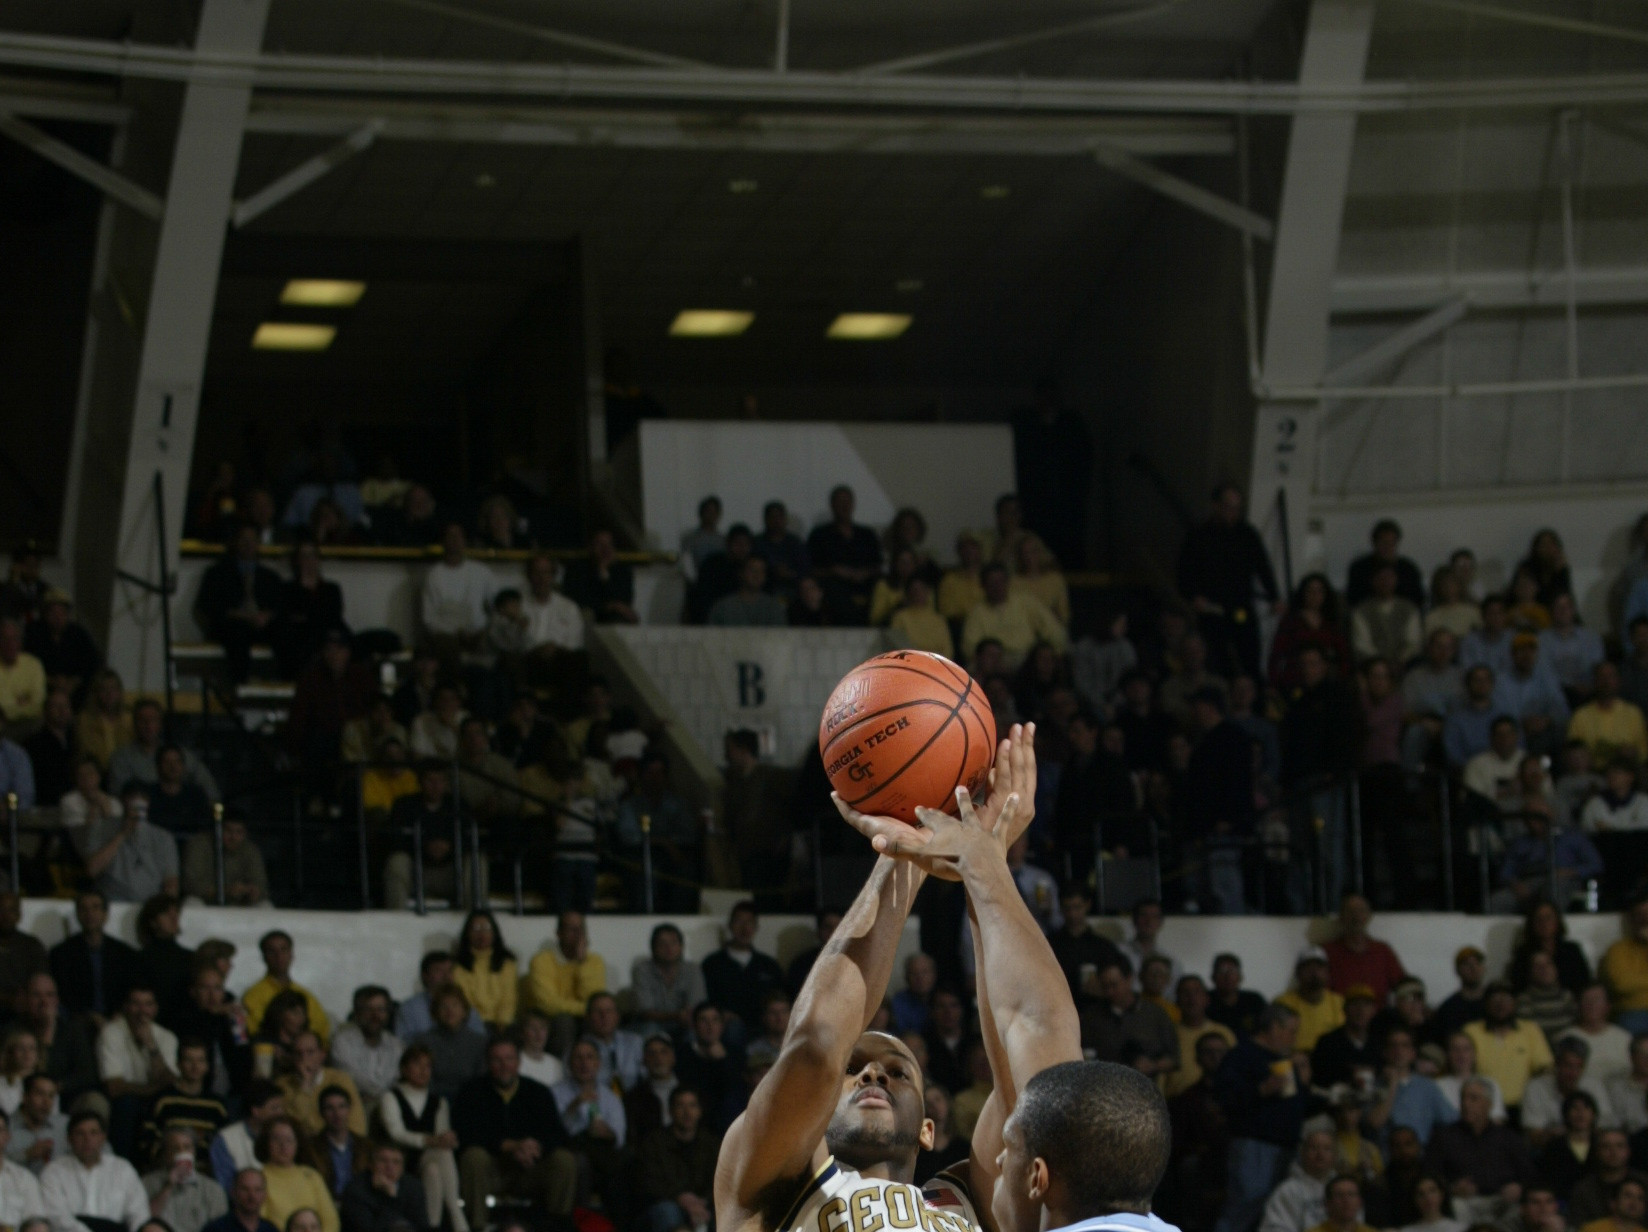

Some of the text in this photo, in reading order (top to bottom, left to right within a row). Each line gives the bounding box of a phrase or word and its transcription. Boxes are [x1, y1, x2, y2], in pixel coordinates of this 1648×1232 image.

[738, 662, 766, 708] B
[864, 716, 910, 749] TECH
[848, 761, 875, 782] GT
